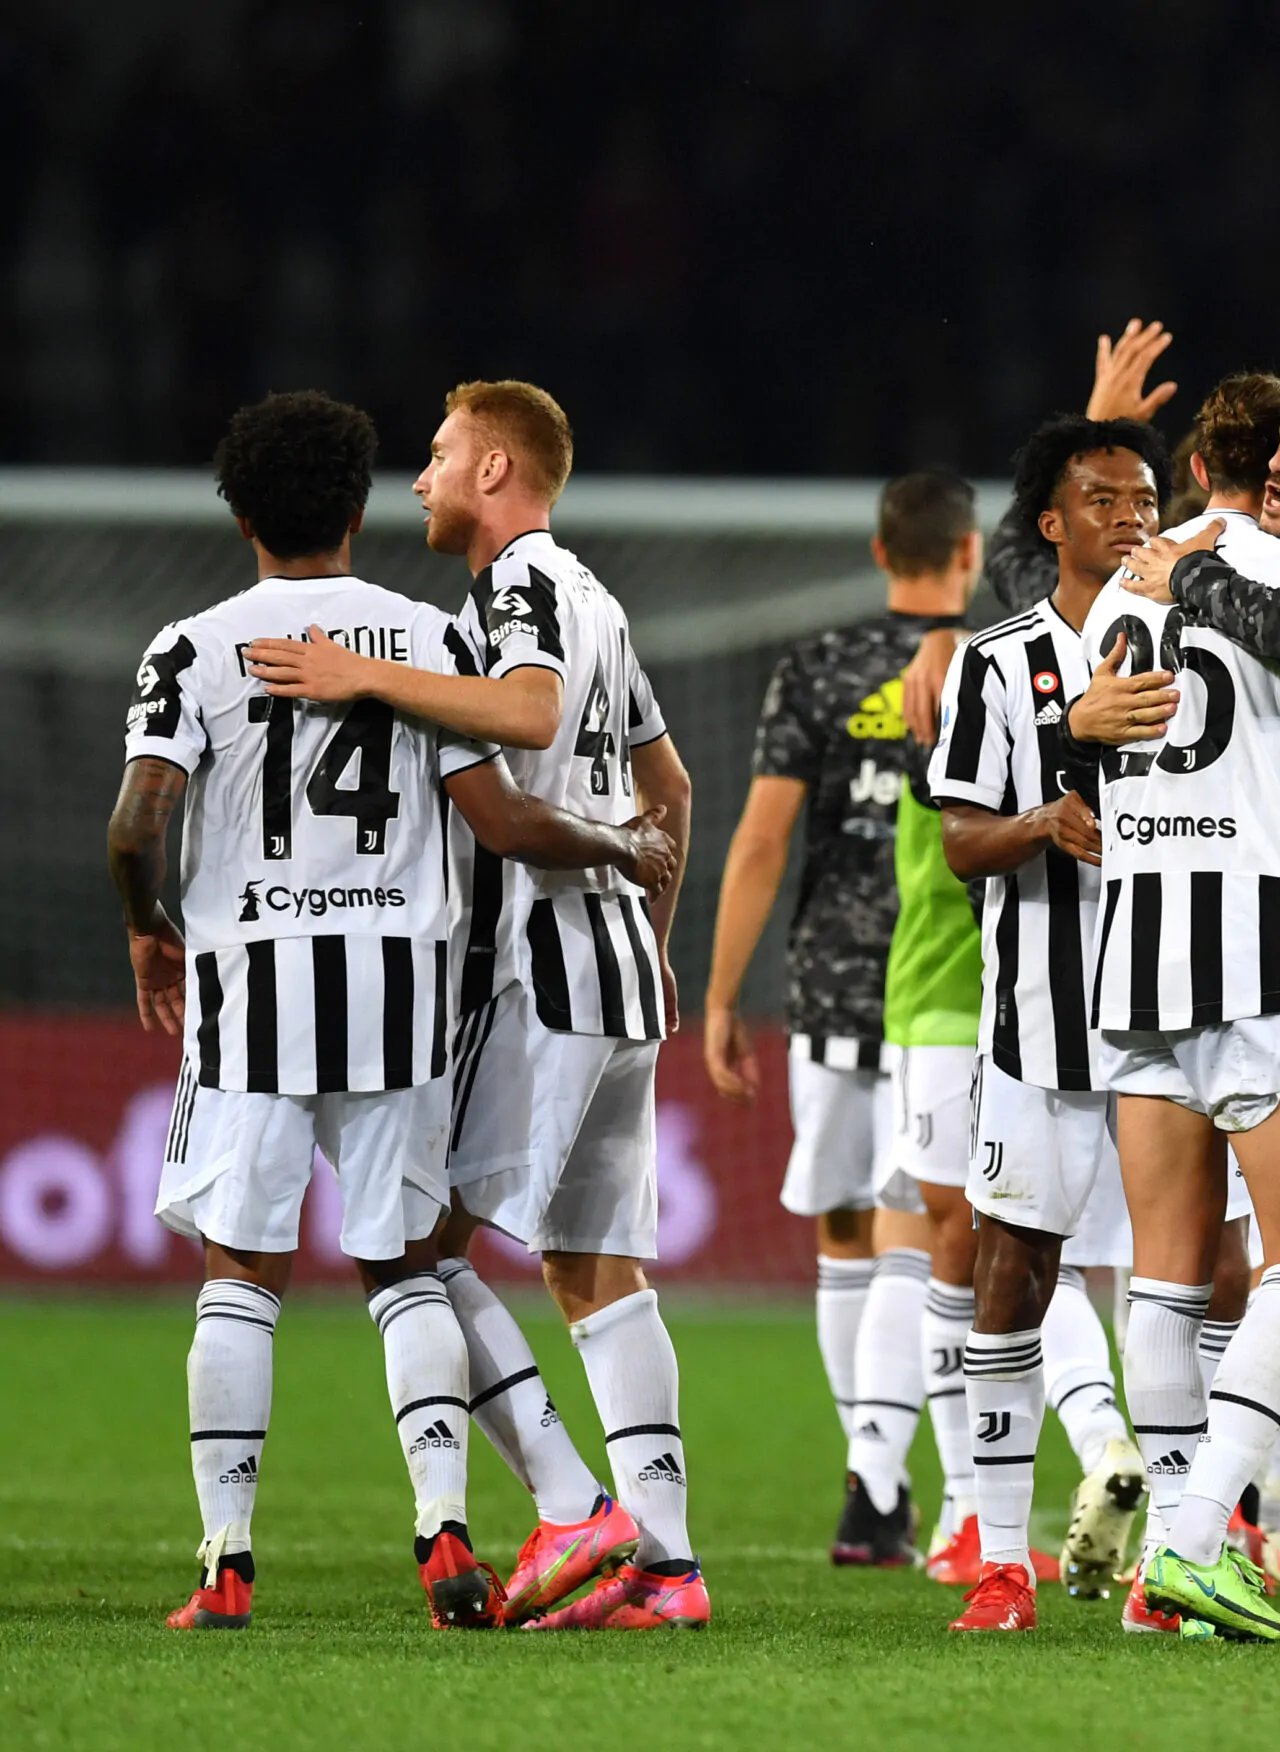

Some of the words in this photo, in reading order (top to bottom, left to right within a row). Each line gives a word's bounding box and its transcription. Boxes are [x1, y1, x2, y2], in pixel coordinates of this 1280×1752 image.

[489, 618, 540, 648] Bitget
[248, 695, 400, 860] 14
[1116, 813, 1237, 846] Cgames
[265, 886, 406, 918] Cygames
[409, 1436, 461, 1454] adidas
[219, 1472, 259, 1484] adida
[1147, 1464, 1191, 1475] adida
